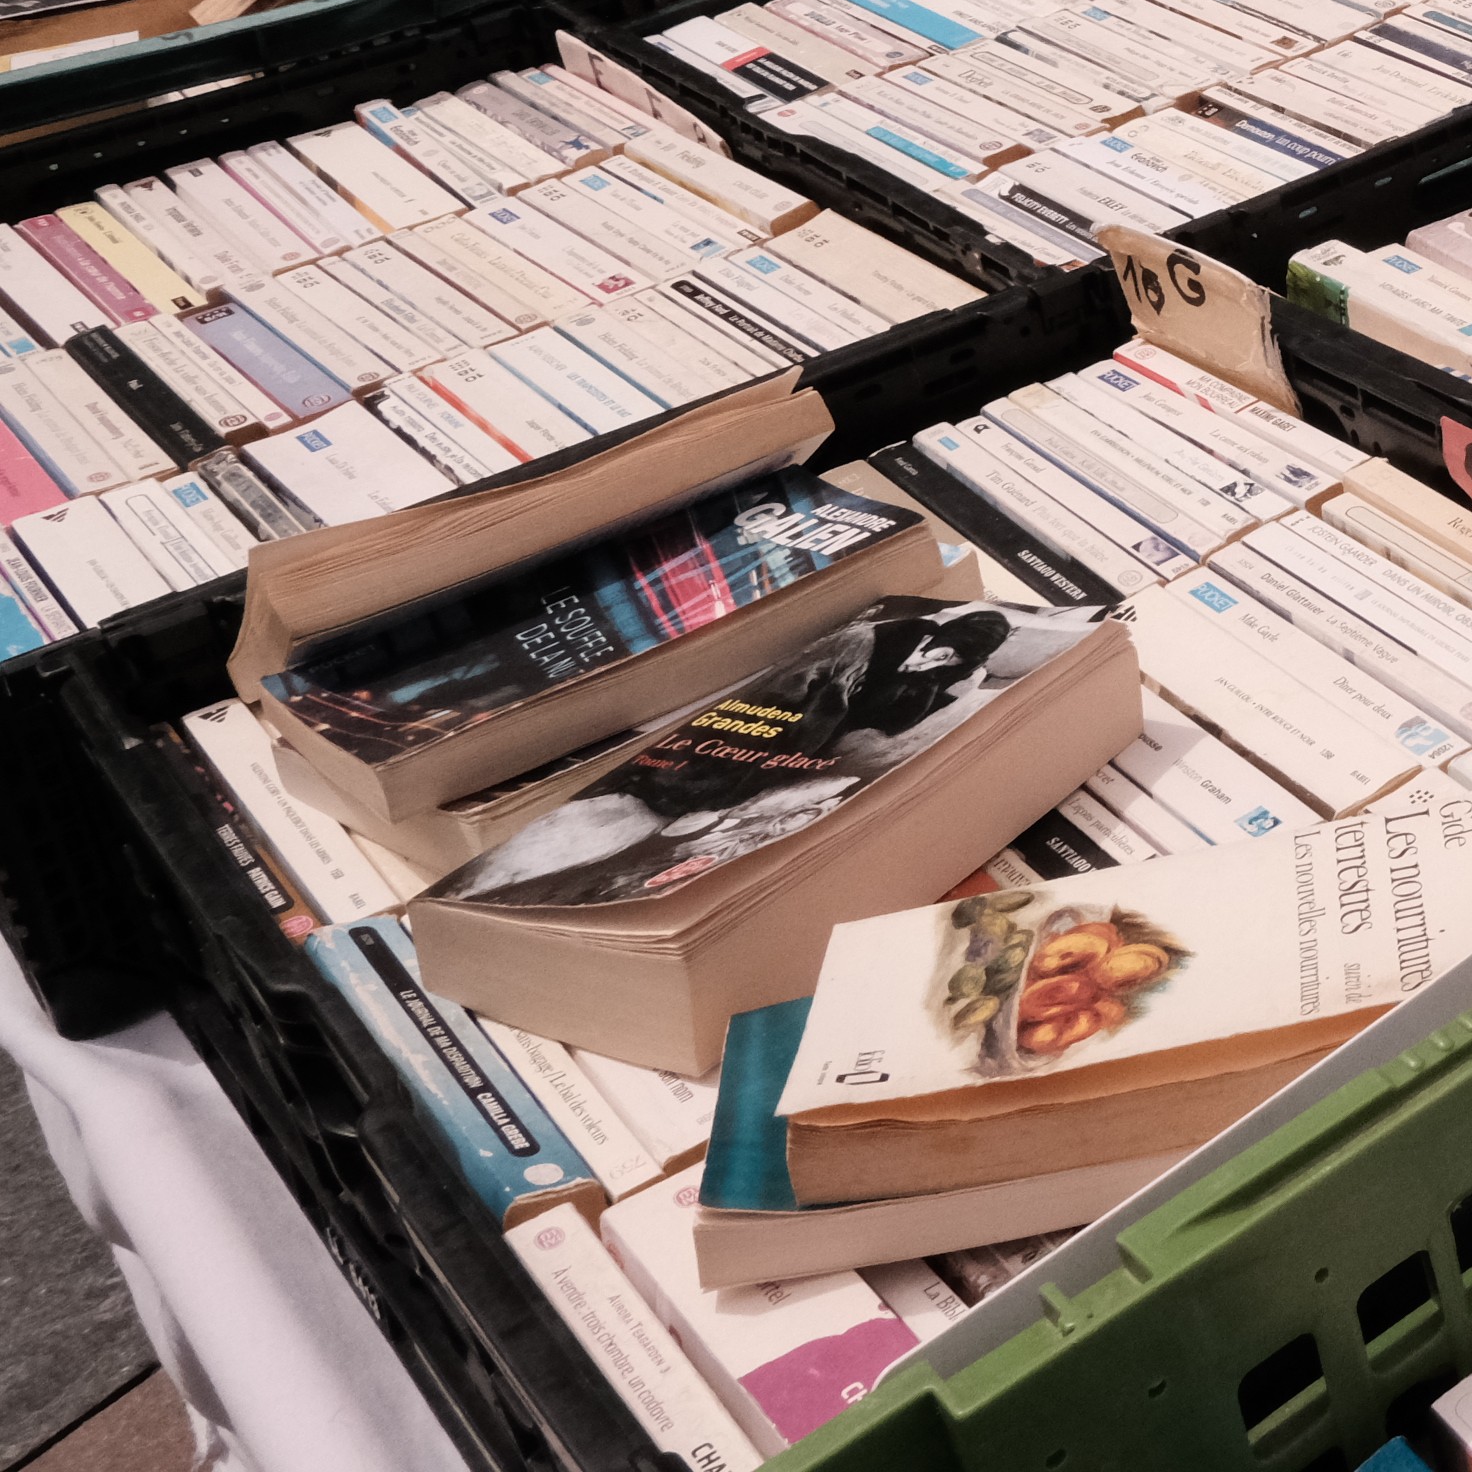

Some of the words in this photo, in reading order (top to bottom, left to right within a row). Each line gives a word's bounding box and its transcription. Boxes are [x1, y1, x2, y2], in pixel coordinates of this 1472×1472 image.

[1166, 249, 1206, 307] G
[734, 502, 871, 556] GALIEN
[811, 503, 898, 533] ALEXANDRE
[1016, 547, 1056, 581] SANTIAGO
[1052, 573, 1088, 601] WESTERN
[690, 711, 784, 739] Grandes
[713, 698, 804, 724] Almudena
[656, 732, 692, 751] Le
[694, 736, 767, 763] Cœur
[763, 751, 838, 772] glacé
[1294, 830, 1321, 860] Les
[1384, 808, 1430, 860] Les
[1295, 862, 1326, 937] nouvelles
[1334, 820, 1375, 935] terrestres
[1390, 863, 1445, 992] nourritures
[1299, 938, 1330, 1016] nourritures
